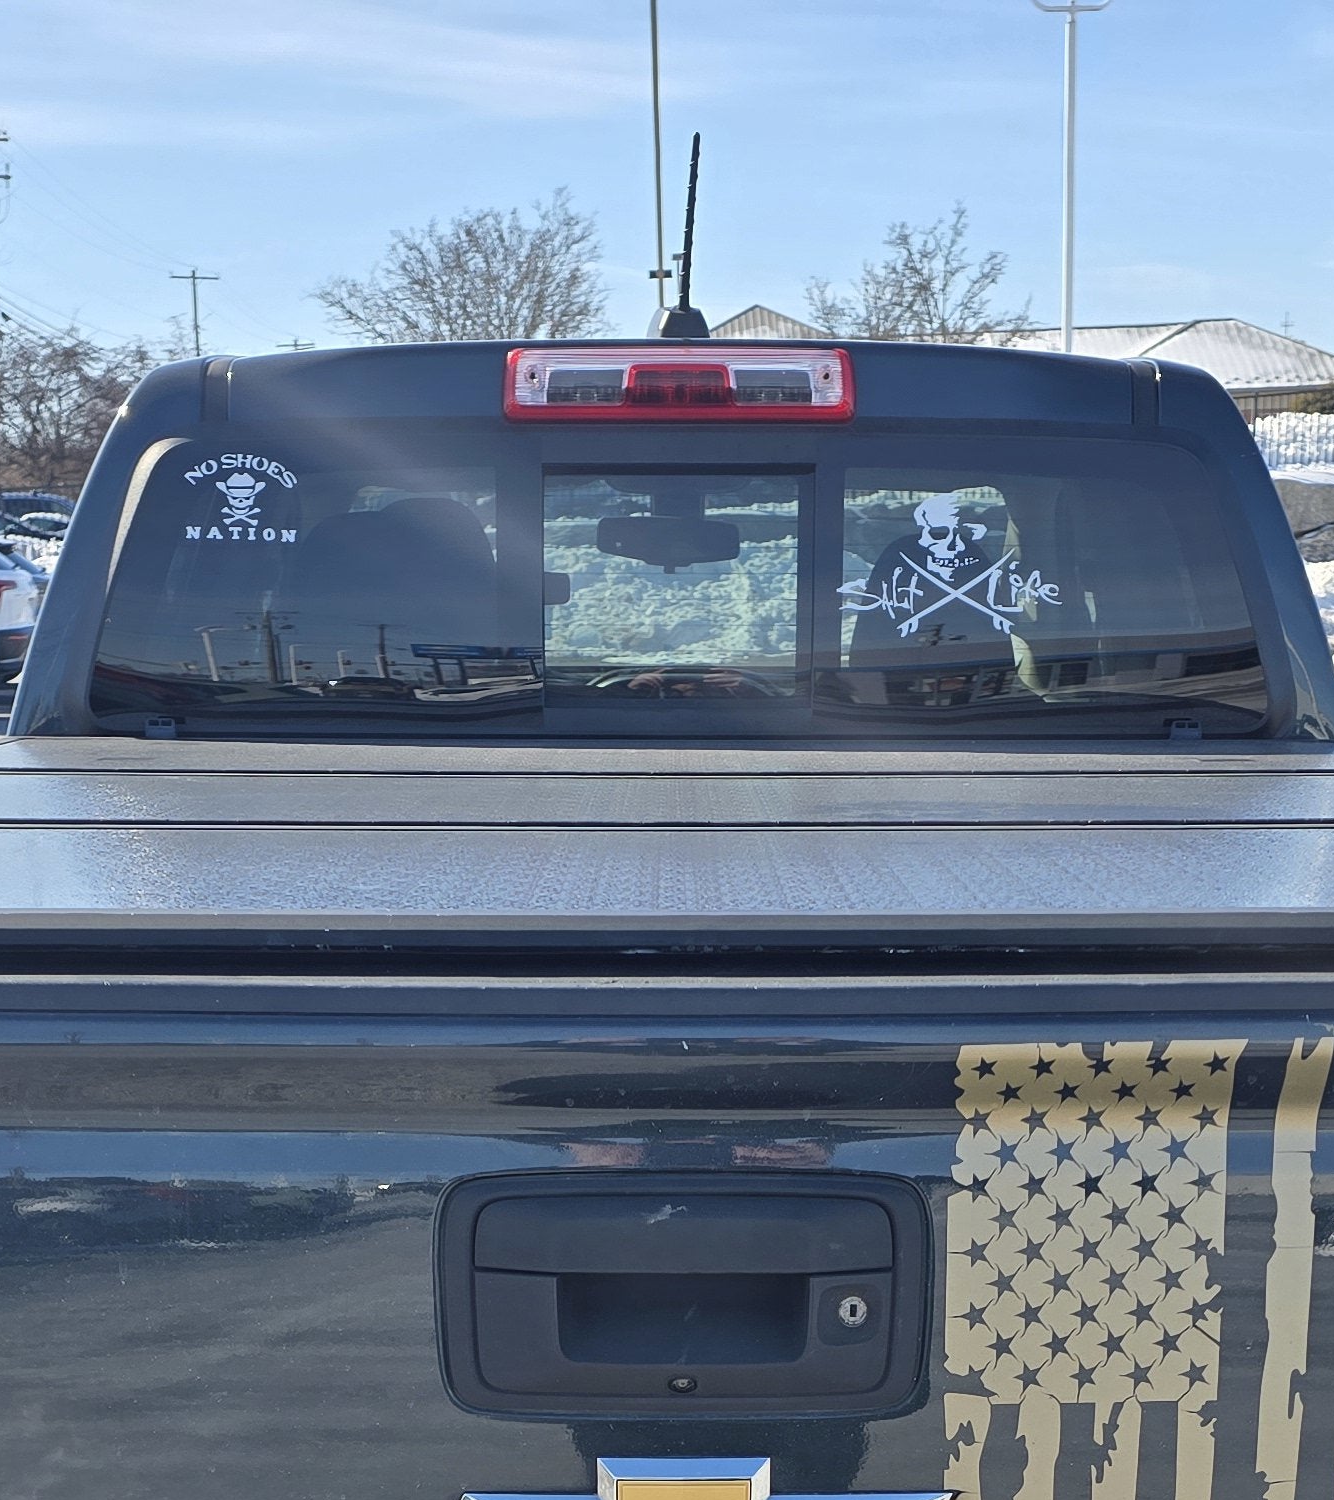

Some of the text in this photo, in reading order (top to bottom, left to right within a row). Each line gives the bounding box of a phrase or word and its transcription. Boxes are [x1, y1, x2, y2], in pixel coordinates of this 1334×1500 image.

[184, 453, 298, 489] NO SHOES
[185, 526, 297, 543] NATION
